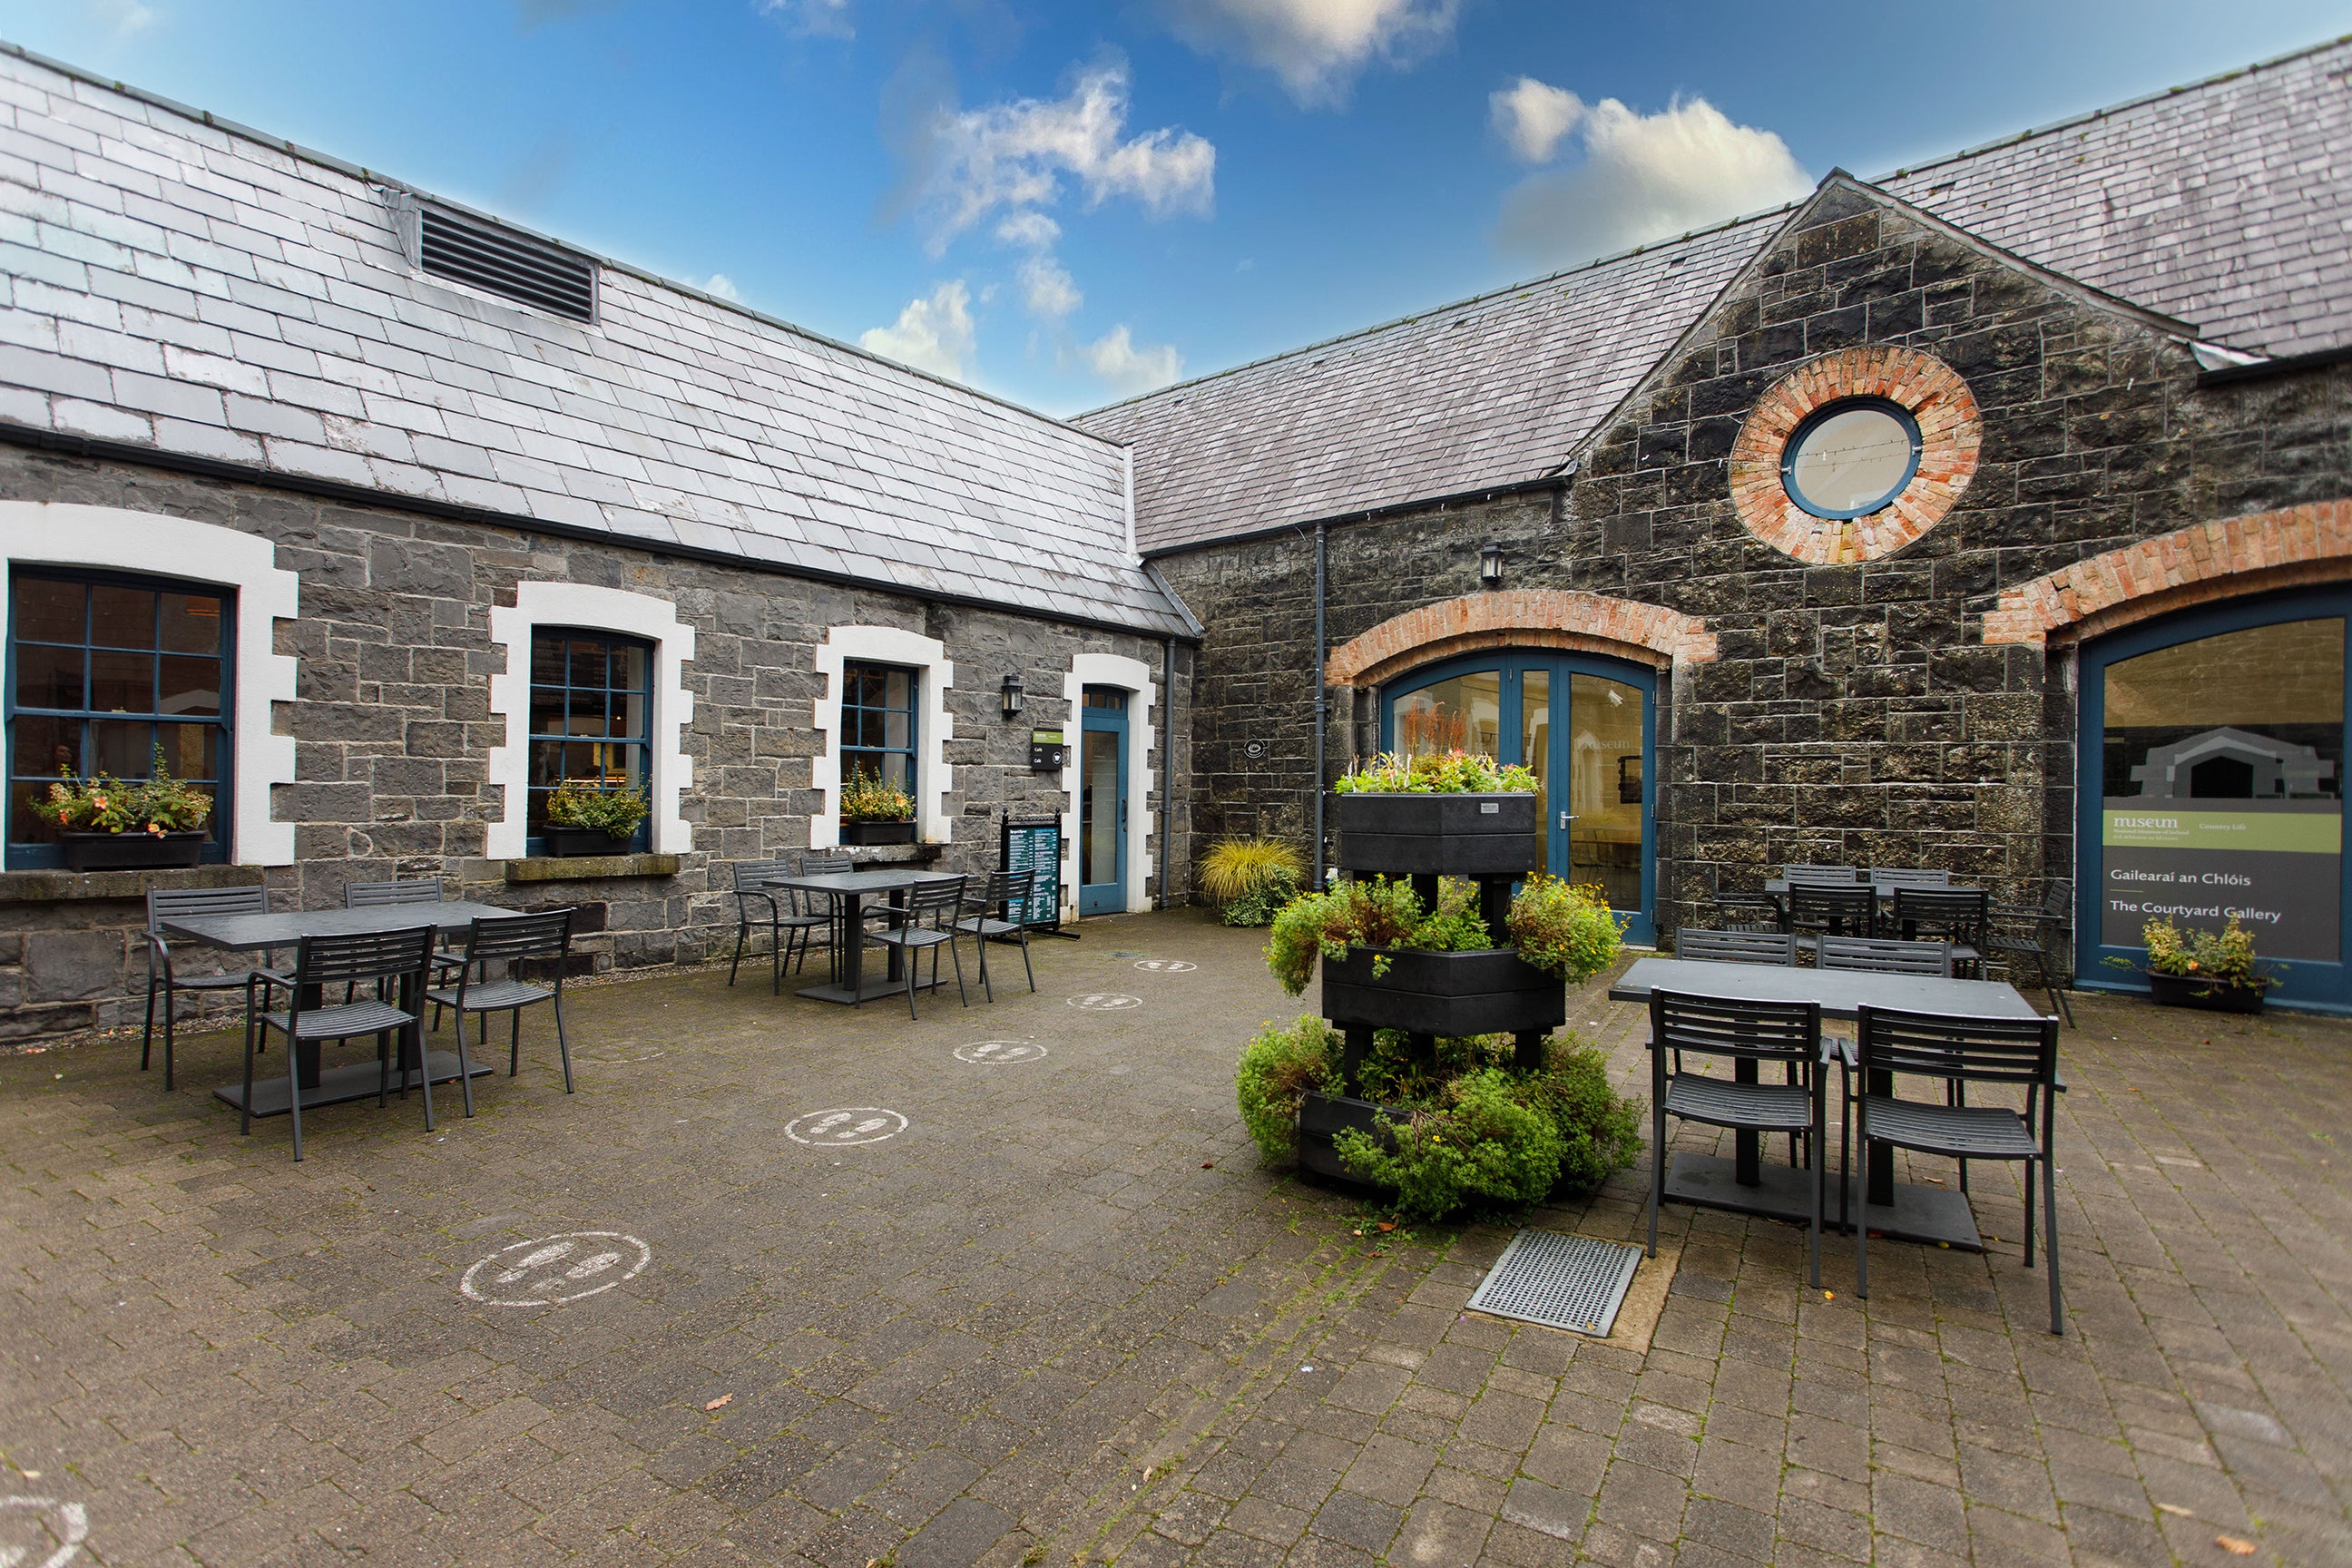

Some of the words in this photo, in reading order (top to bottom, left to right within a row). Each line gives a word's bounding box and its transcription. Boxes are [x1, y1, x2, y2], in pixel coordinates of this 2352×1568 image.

[2113, 817, 2178, 828] museum
[2199, 823, 2230, 831] Country
[2231, 823, 2247, 831] Life
[2110, 868, 2174, 883] Gailearaí
[2178, 873, 2197, 883] an
[2201, 872, 2251, 886] Chlóis
[2110, 900, 2138, 913] The
[2141, 901, 2220, 918] Courtyard
[2224, 906, 2281, 924] Gallery
